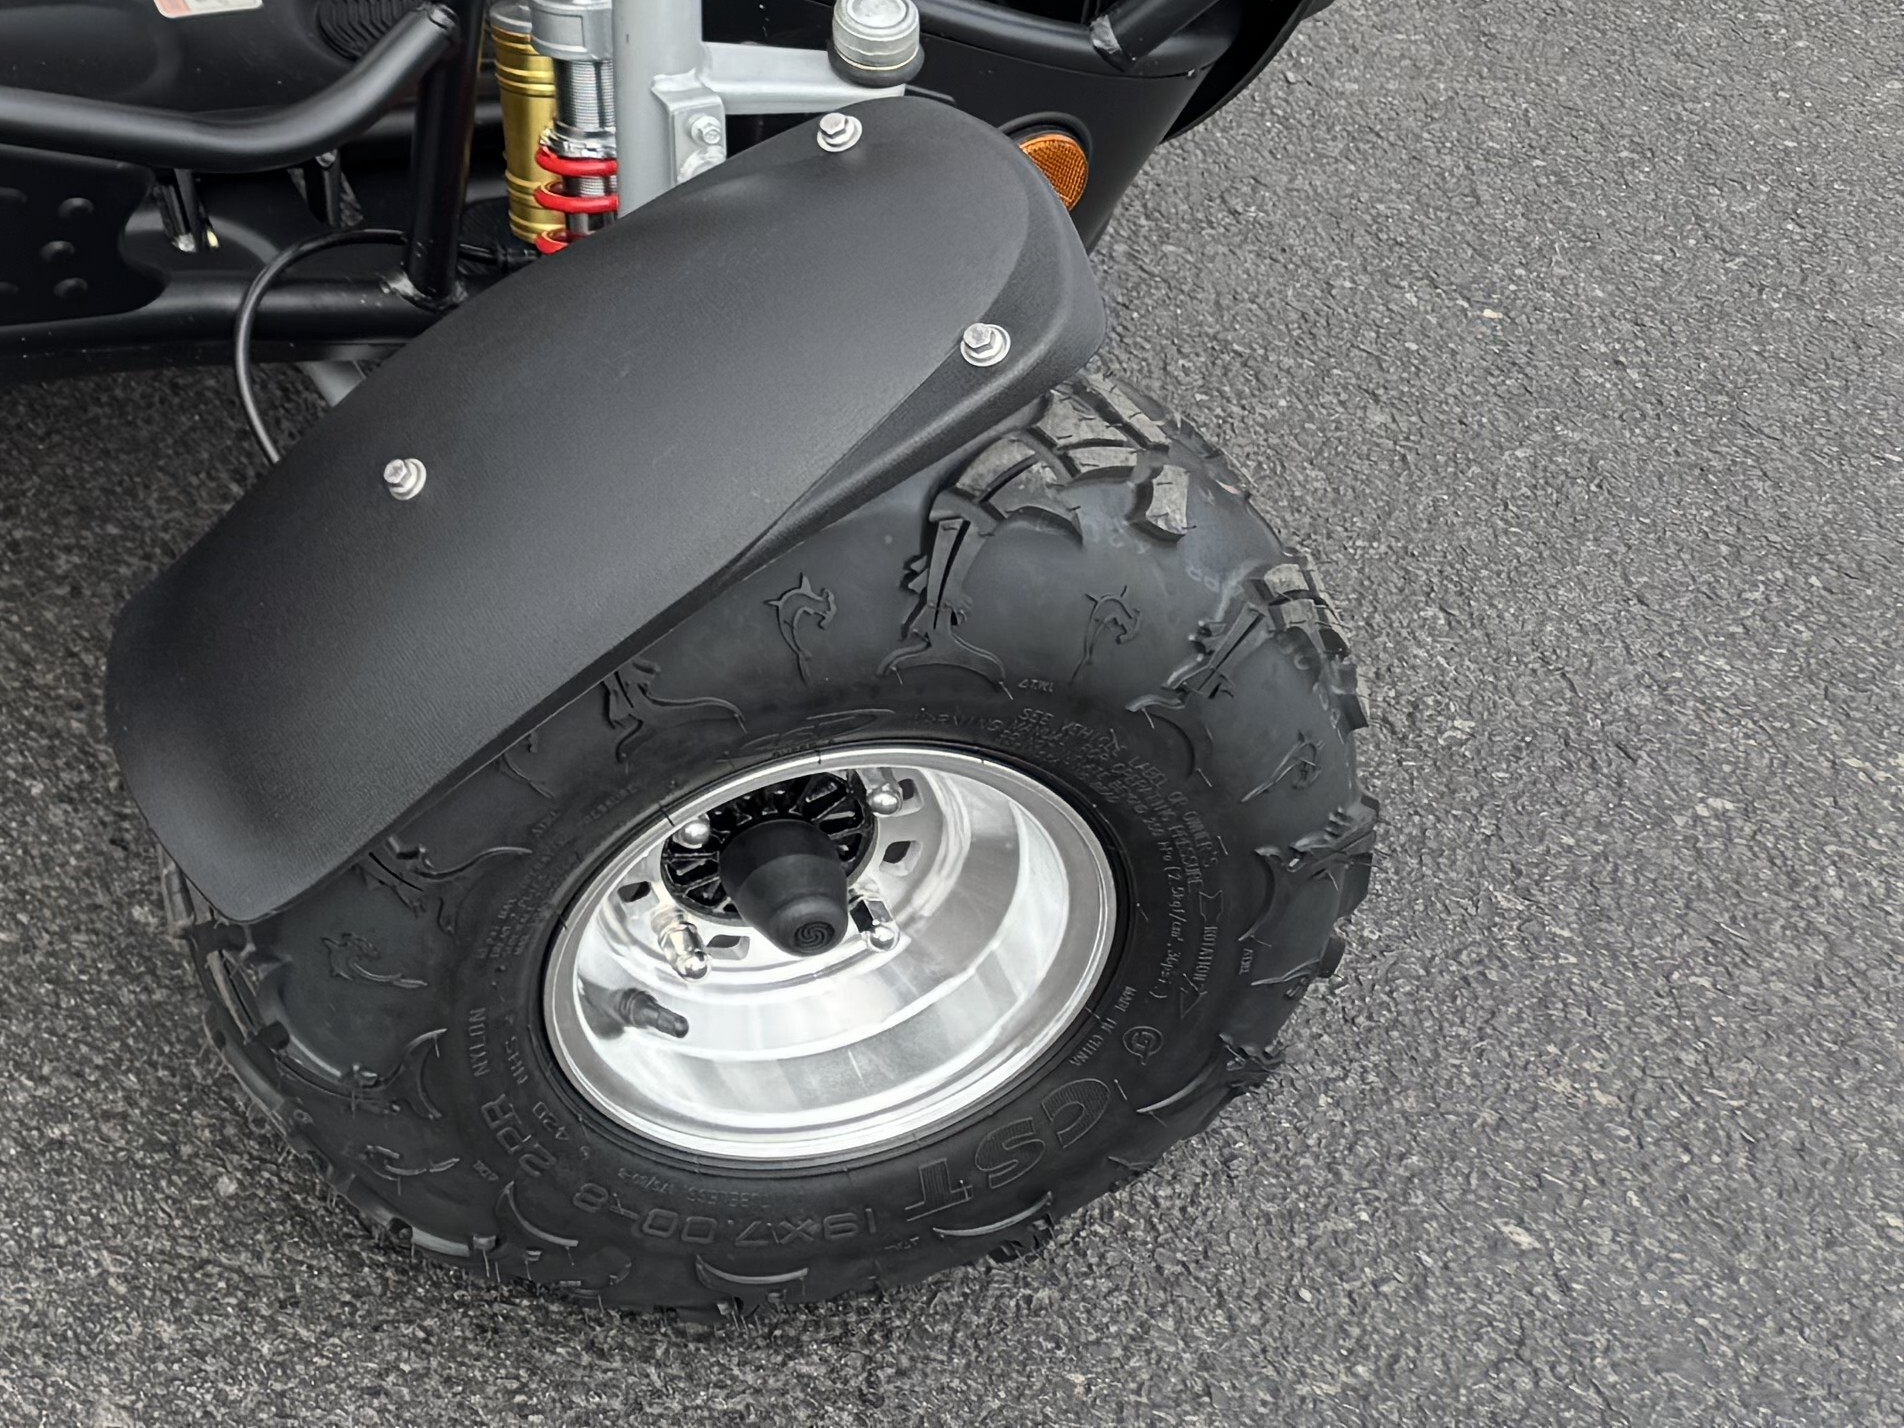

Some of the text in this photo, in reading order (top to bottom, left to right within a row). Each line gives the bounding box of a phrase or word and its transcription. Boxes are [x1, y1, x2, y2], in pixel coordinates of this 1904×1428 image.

[1168, 824, 1205, 889] PRESSURE
[1191, 925, 1219, 988] ROTATION
[467, 1007, 492, 1079] NYLON
[905, 1075, 1111, 1223] CST
